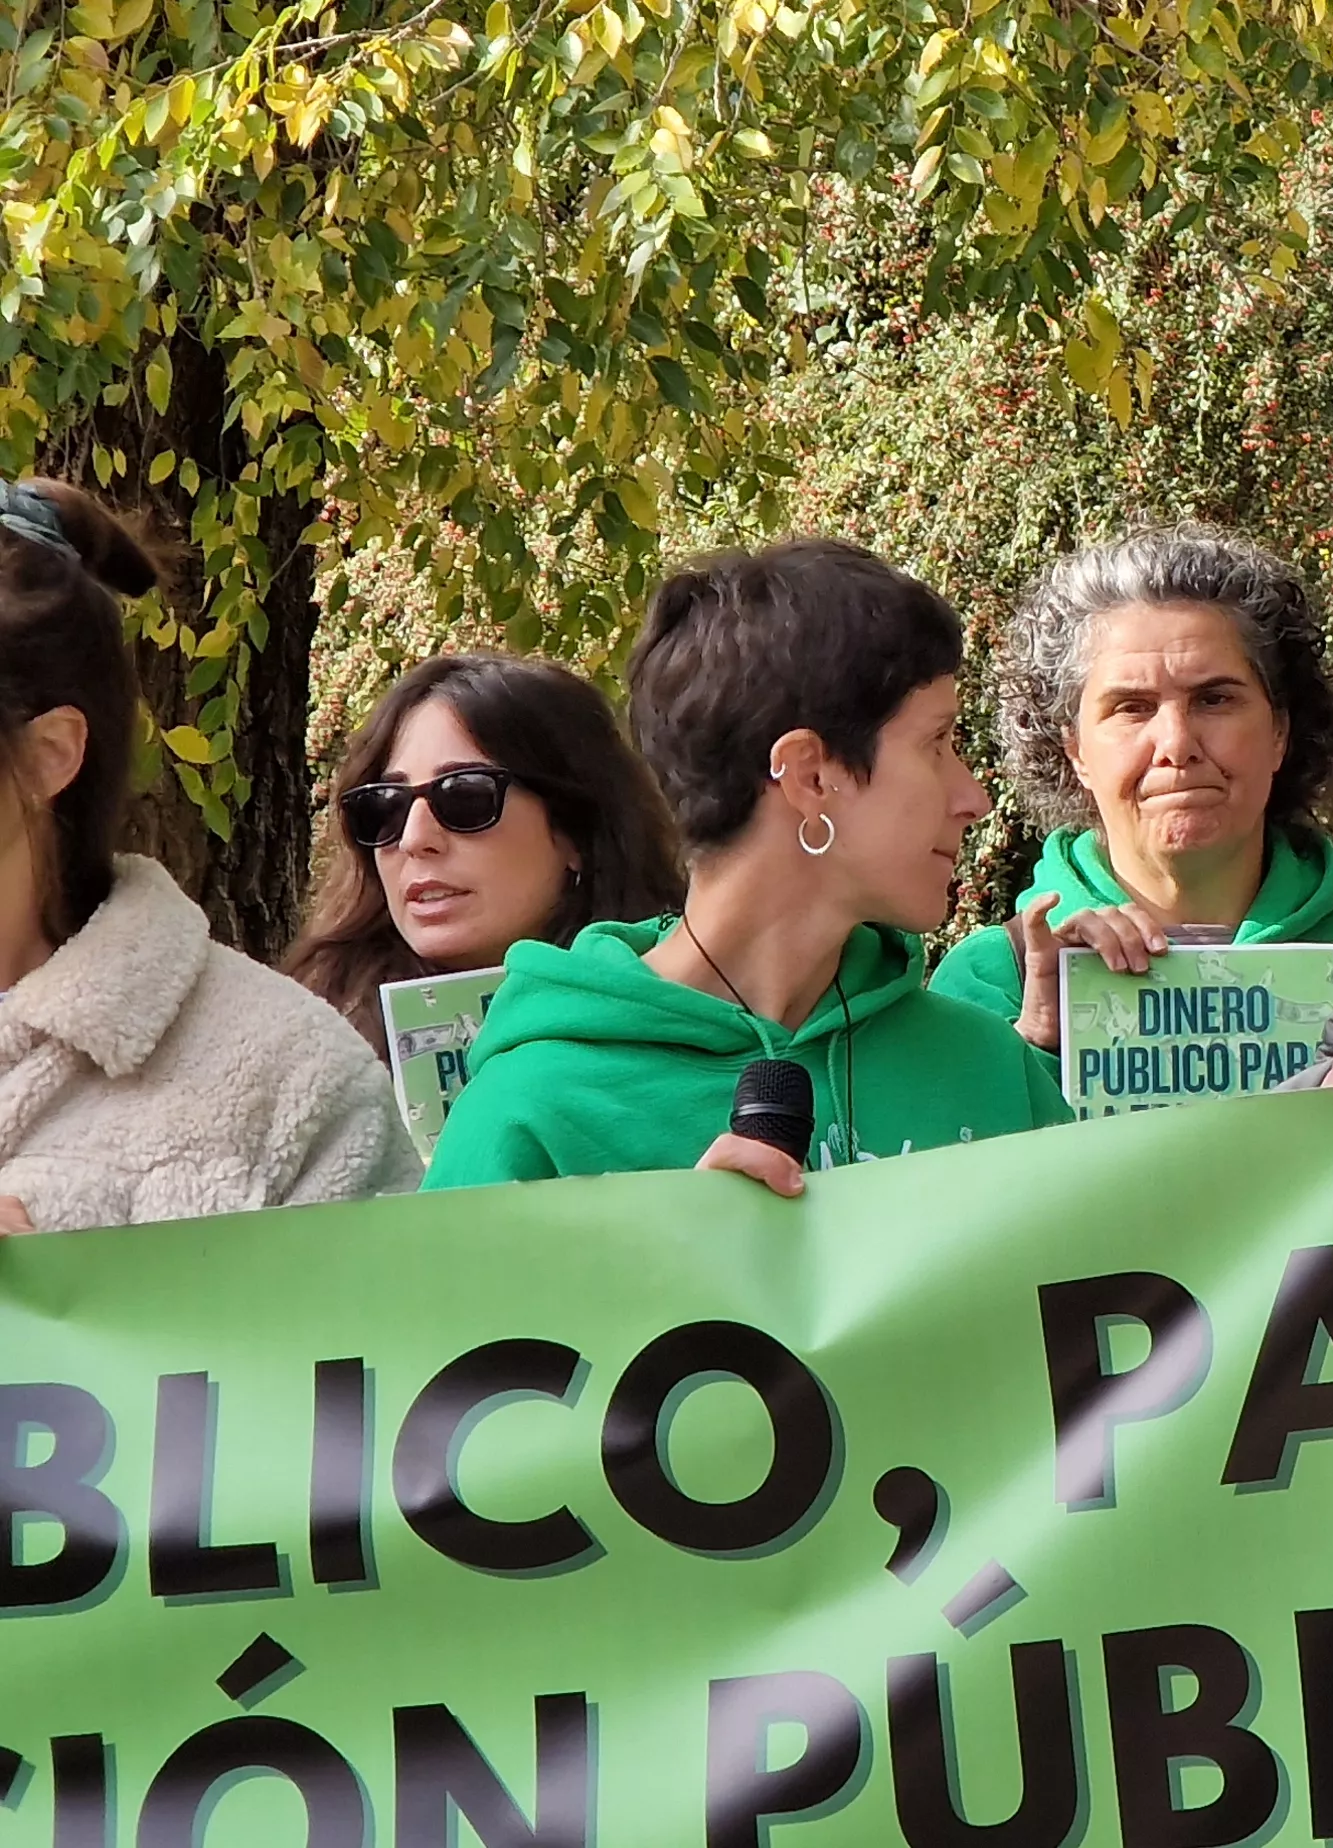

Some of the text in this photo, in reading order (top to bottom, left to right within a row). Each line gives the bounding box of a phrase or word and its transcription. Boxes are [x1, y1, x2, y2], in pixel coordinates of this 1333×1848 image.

[1137, 985, 1270, 1037] DINERO
[1078, 1036, 1322, 1097] PÚBLICO PAR
